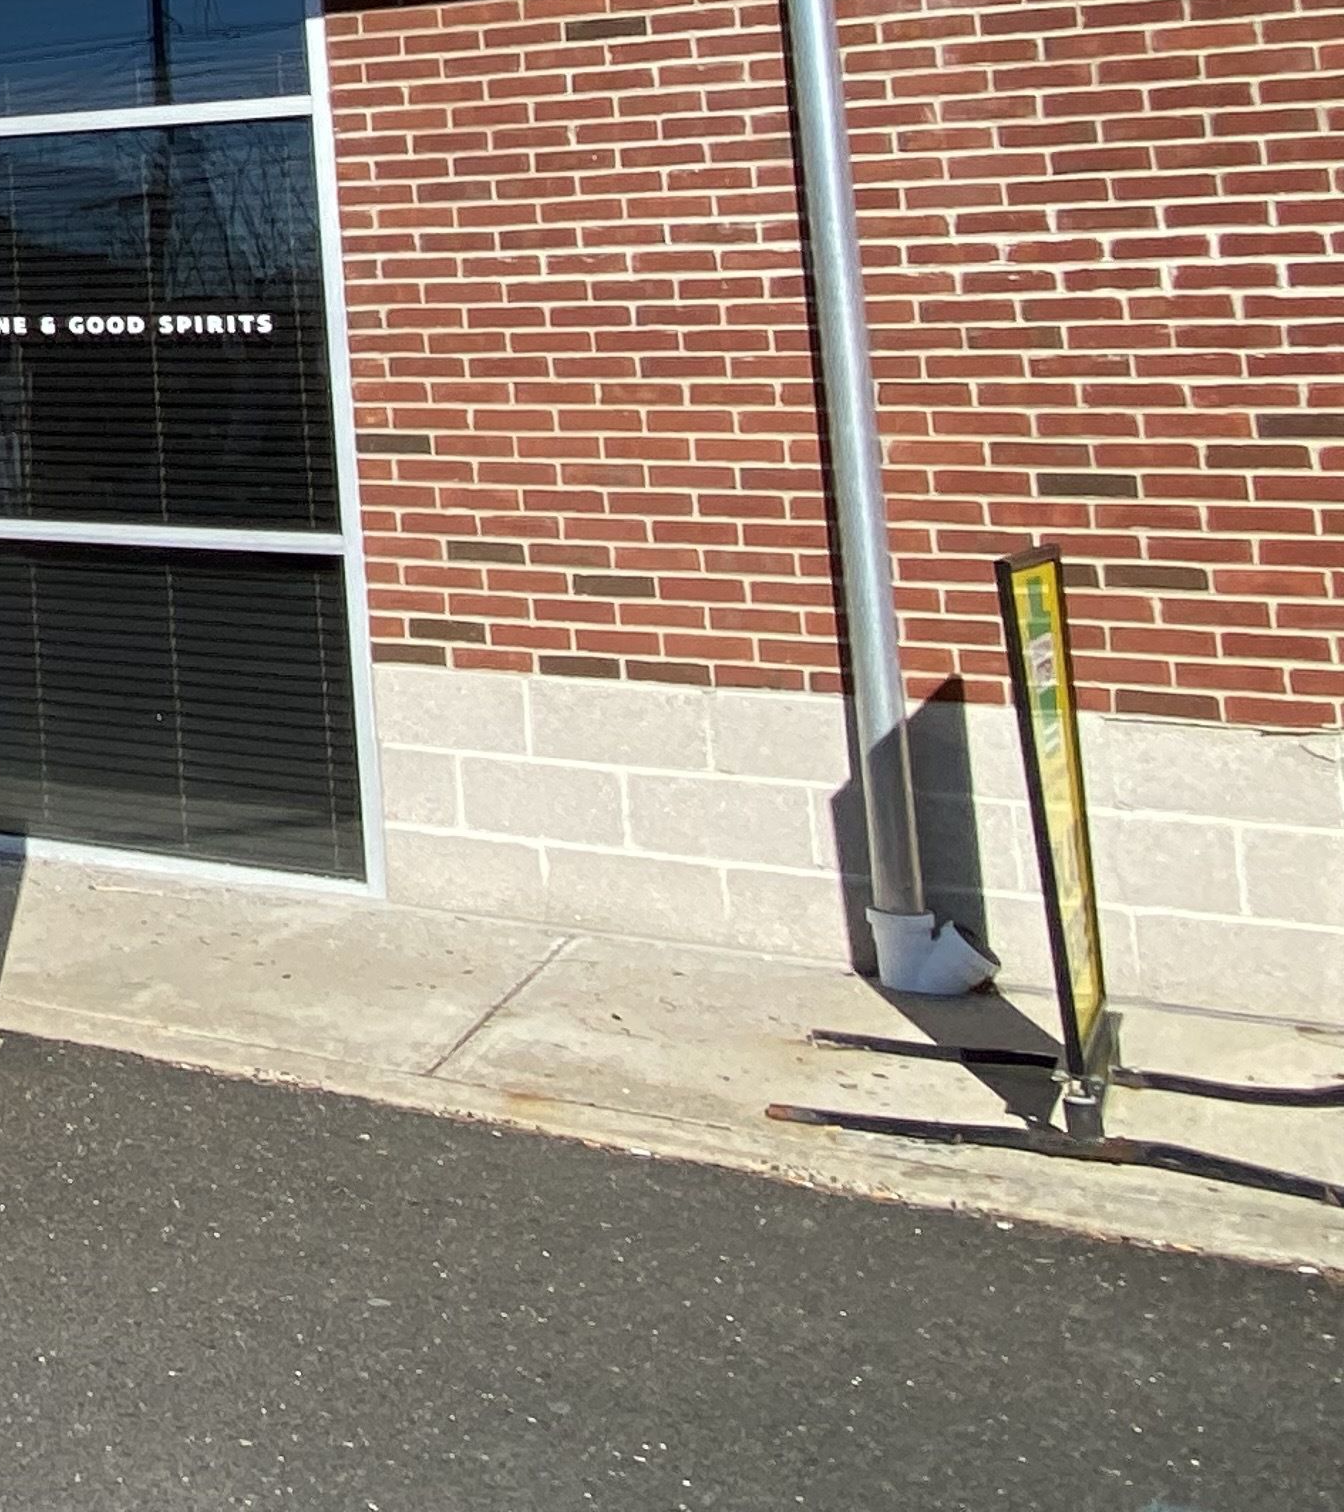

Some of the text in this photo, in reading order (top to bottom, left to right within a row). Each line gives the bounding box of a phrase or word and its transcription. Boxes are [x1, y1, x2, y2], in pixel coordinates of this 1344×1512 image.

[40, 316, 56, 335] &
[68, 315, 145, 335] GOOD
[158, 314, 274, 334] SPIRITS
